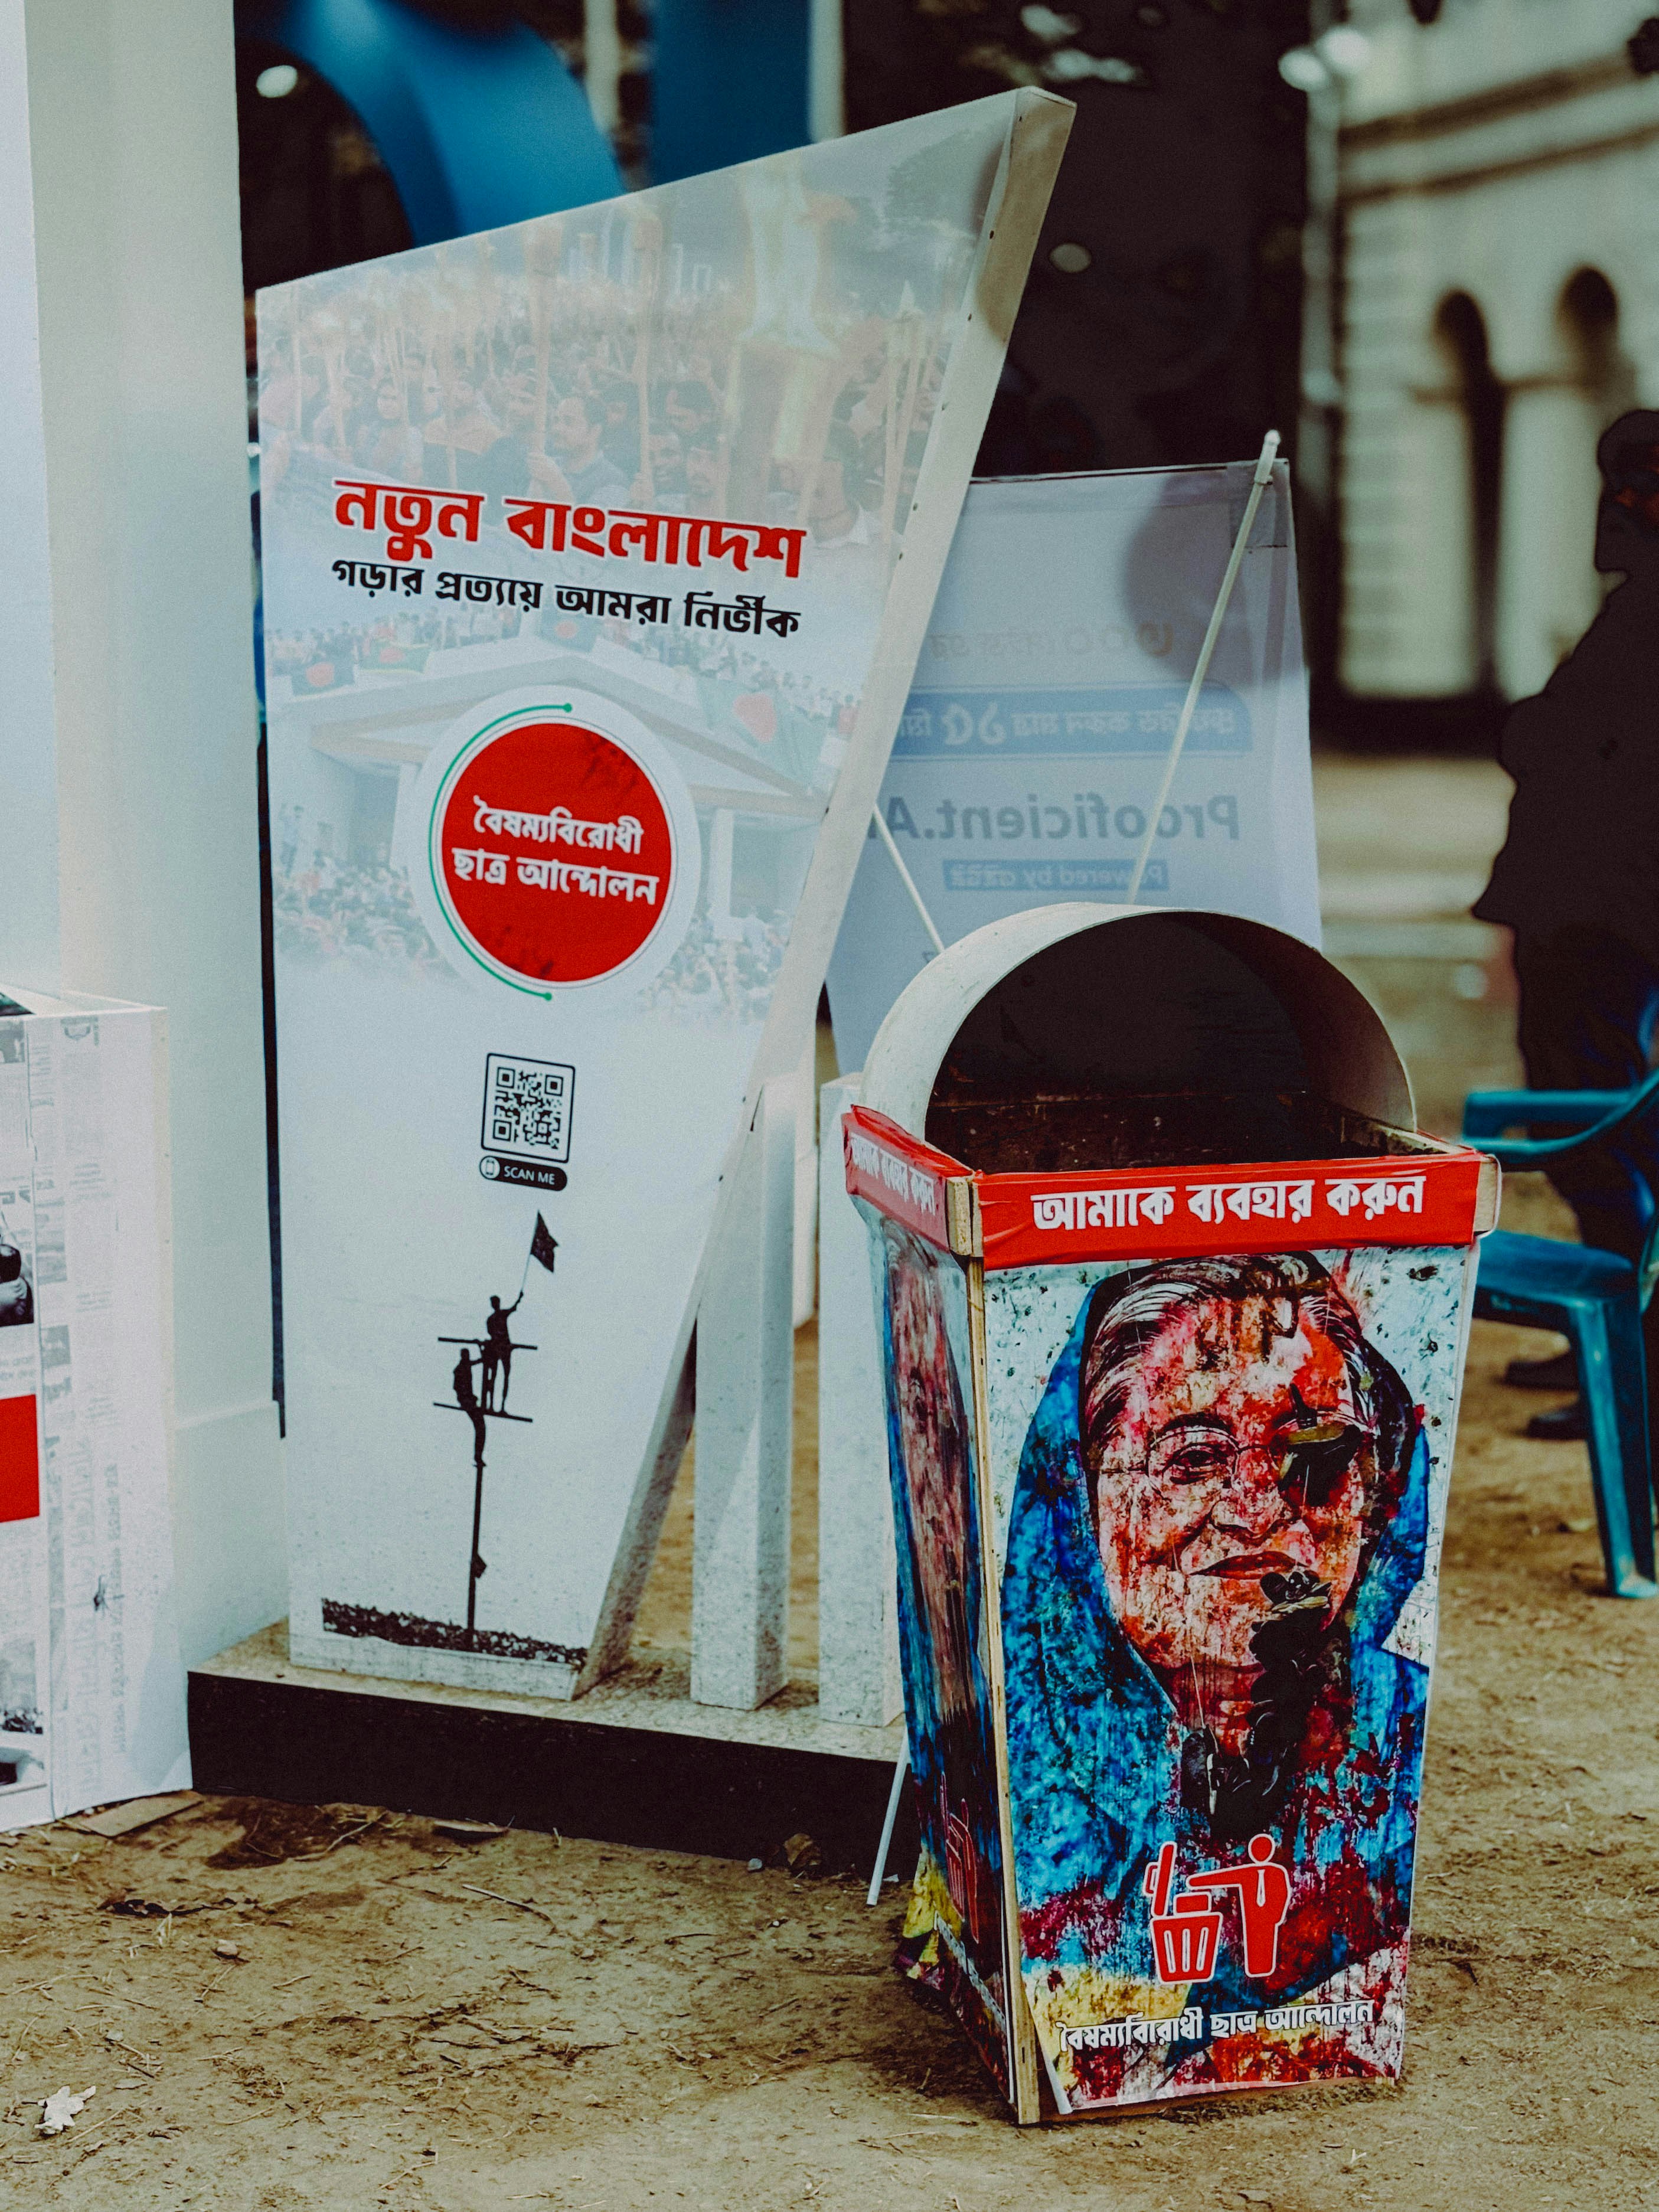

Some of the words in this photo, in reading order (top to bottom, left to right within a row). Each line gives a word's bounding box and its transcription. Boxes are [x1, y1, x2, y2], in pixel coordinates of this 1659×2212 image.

[334, 481, 484, 560] নতুন
[505, 498, 806, 579] বাংলাদেশ
[332, 559, 423, 598] গড়ার
[436, 571, 543, 612] প্রত্যয়ে
[556, 584, 672, 626] আমরা
[684, 592, 801, 638] নির্ভীক
[473, 794, 644, 855] বৈষম্যবিরোধী
[452, 847, 510, 886] ছাত্র
[515, 857, 659, 906] আন্দোলন
[504, 1165, 535, 1182] SCAN
[537, 1172, 556, 1185] ME
[1030, 1185, 1177, 1231] আমাকে
[1185, 1179, 1316, 1224] ব্যবহার
[1324, 1174, 1427, 1221] করুন
[1056, 2006, 1205, 2052] বৈষম্যবিরোধী
[1209, 2010, 1259, 2038] ছাত্র
[1263, 1999, 1376, 2031] আন্দোলন
